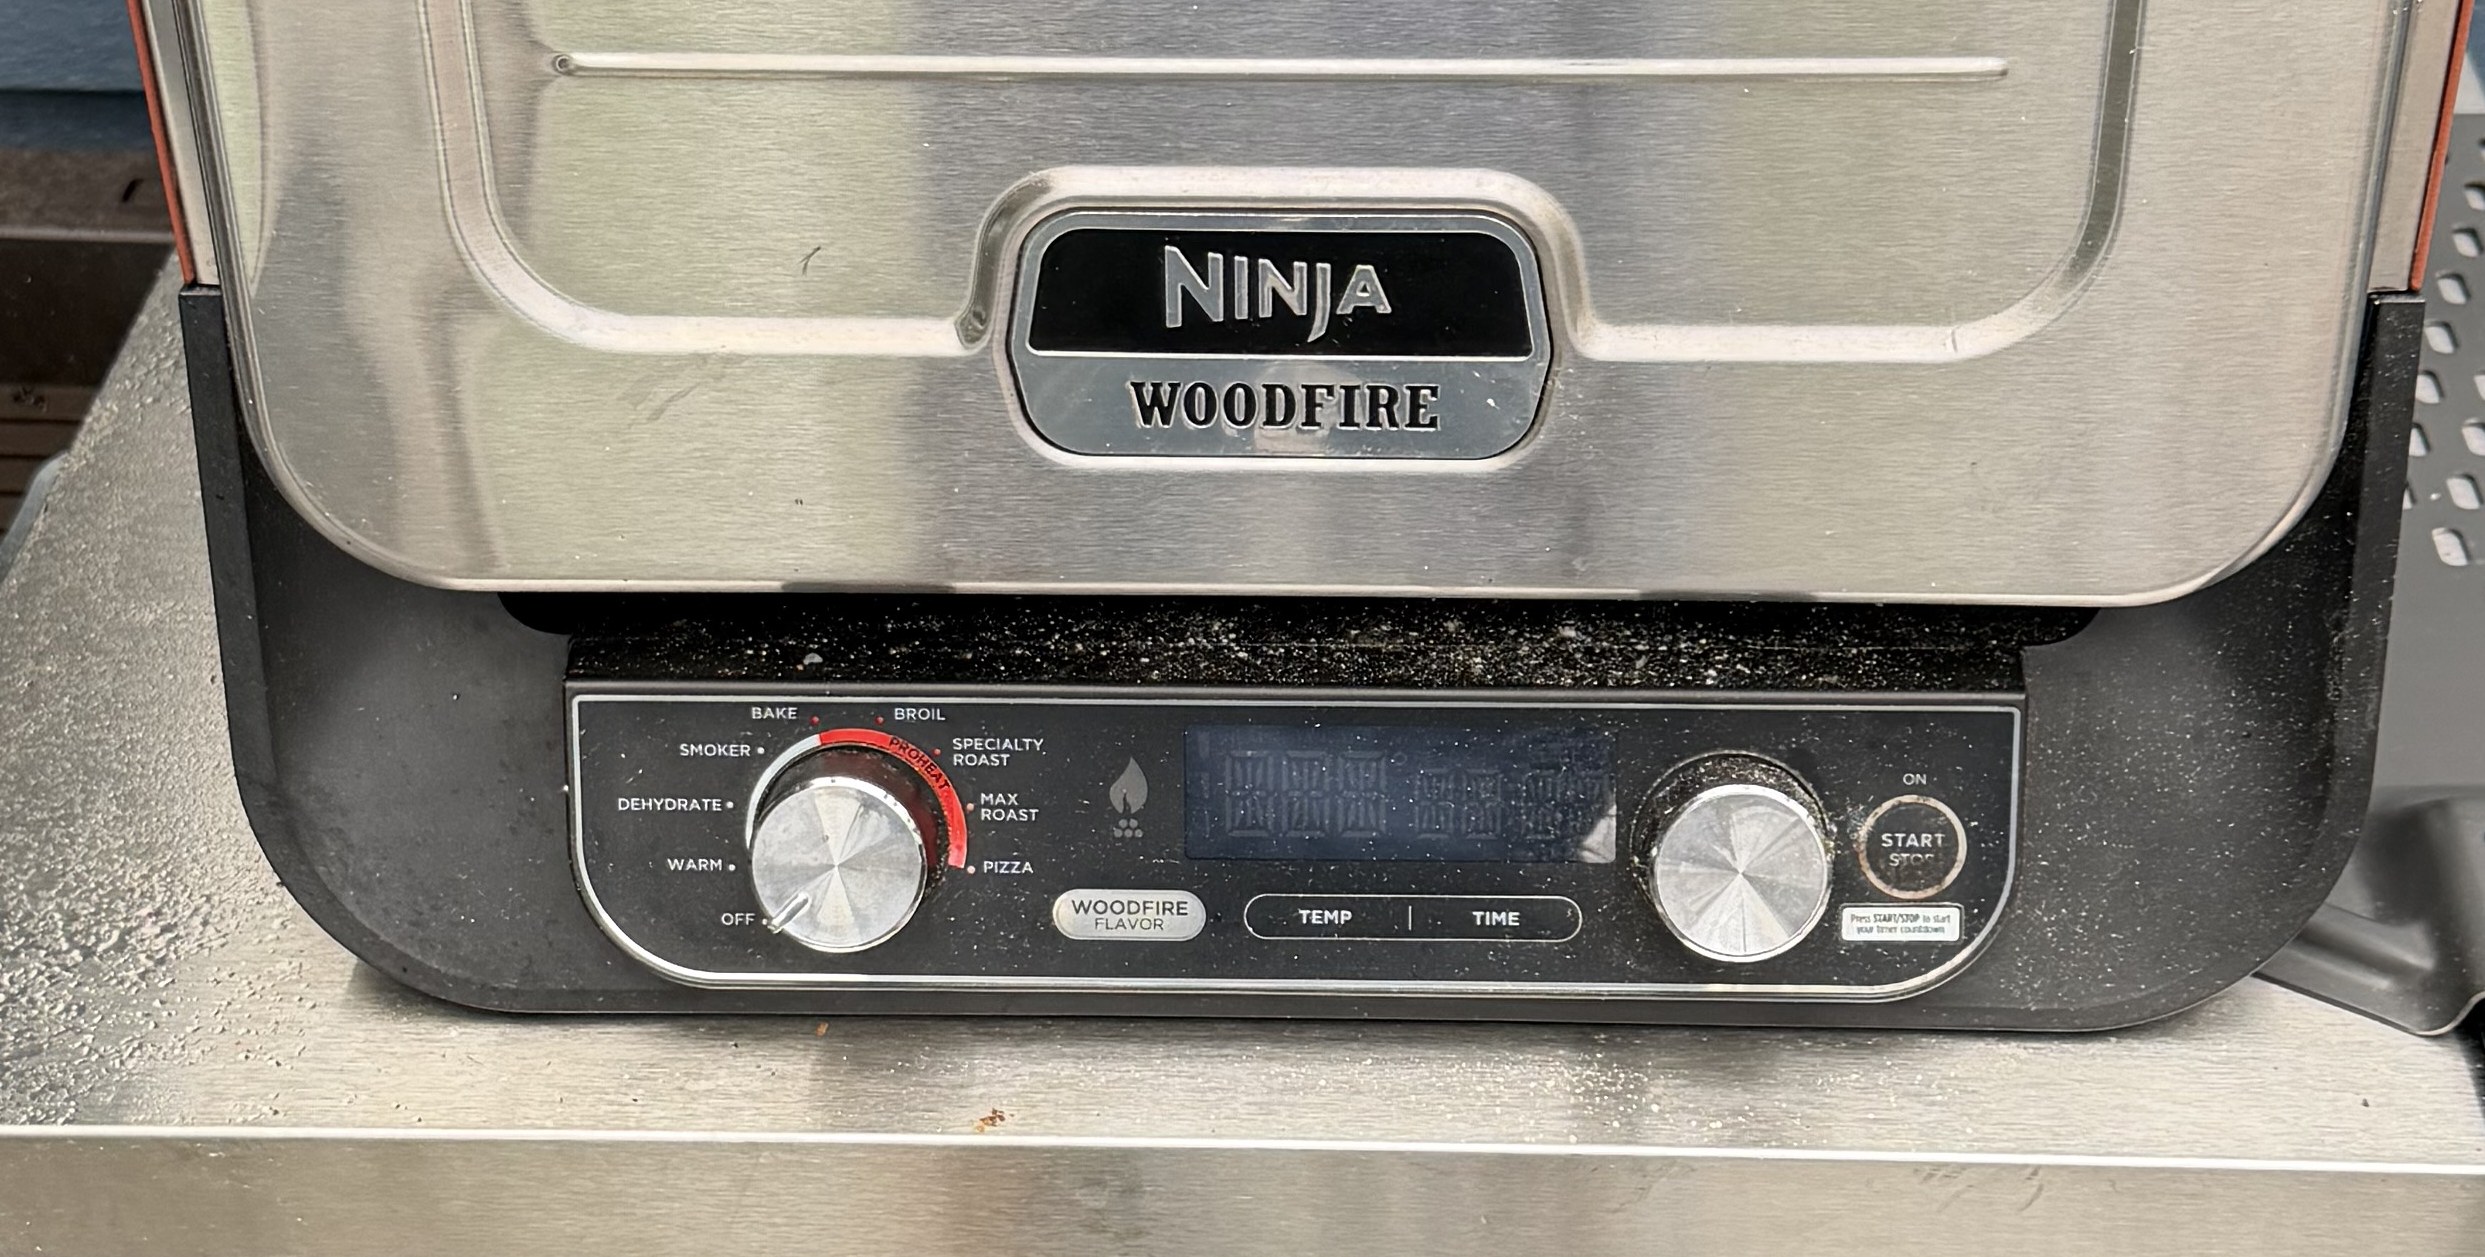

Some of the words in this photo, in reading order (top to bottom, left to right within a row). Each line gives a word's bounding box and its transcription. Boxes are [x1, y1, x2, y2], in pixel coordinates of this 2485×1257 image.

[1163, 244, 1393, 344] NINJA
[1128, 379, 1441, 433] WOODFIRE
[751, 706, 798, 720] BAKE
[894, 707, 946, 721] BROIL
[679, 743, 751, 758] SMOKER
[952, 737, 1044, 752] SPECIALTY
[889, 736, 951, 790] PROHEAT
[953, 752, 1011, 767] ROAST
[1902, 772, 1928, 786] ON
[617, 797, 723, 813] DEHYDRATE
[980, 792, 1020, 806] MAX
[980, 807, 1040, 822] ROAST
[1881, 832, 1946, 849] START
[667, 857, 723, 872] WARM
[983, 860, 1034, 875] PIZZA
[1071, 898, 1190, 918] WOODFIRE
[720, 912, 756, 927] OFF
[1093, 915, 1165, 931] FLAVOR
[1299, 908, 1353, 926] TEMP
[1472, 910, 1521, 928] TIME
